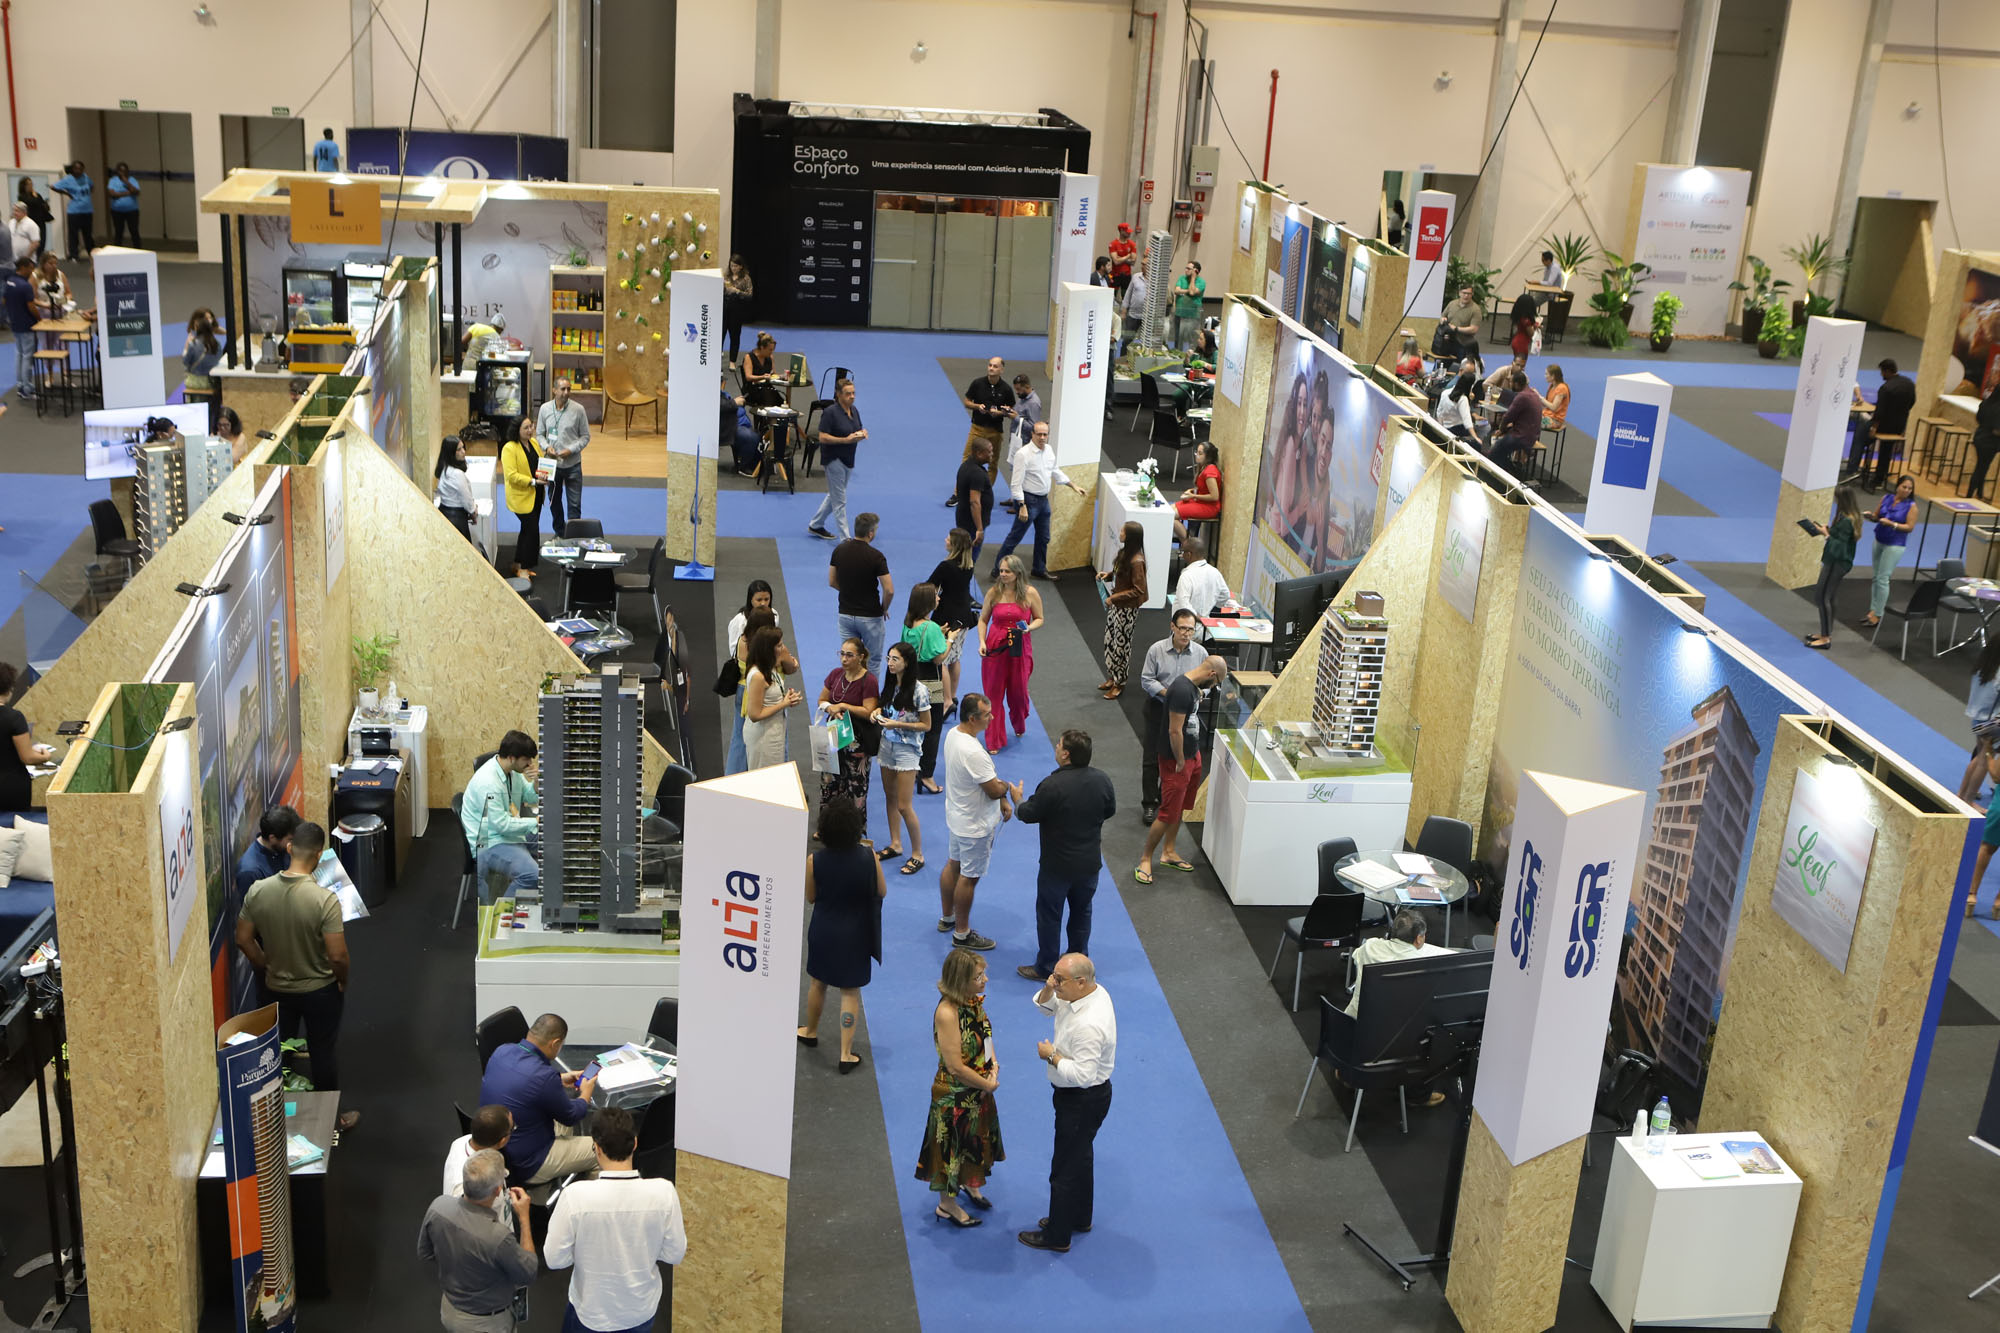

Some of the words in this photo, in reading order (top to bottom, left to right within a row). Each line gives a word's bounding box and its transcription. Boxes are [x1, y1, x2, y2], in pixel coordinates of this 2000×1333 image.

[794, 160, 859, 179] Conforto
[795, 145, 848, 161] Espaço
[871, 160, 890, 168] Uma
[891, 161, 932, 170] experiência
[934, 163, 966, 171] sensorial
[985, 165, 1017, 173] Acústica
[1024, 166, 1063, 175] Iluminação
[1078, 197, 1089, 227] PRIMA
[701, 304, 709, 336] HELENA
[1086, 310, 1095, 360] CONCRETA
[700, 337, 708, 366] SANTA
[1445, 529, 1470, 577] Leaf
[1528, 566, 1547, 592] SEU
[1546, 581, 1560, 604] 2/4
[1560, 591, 1584, 624] COM
[1585, 611, 1615, 649] SUÍTE
[1616, 635, 1624, 657] E
[1526, 589, 1567, 641] VARANDA
[1570, 629, 1622, 689] GOURMET.
[1521, 616, 1535, 639] NO
[1536, 628, 1570, 671] MORRO
[1572, 660, 1622, 719] IPIRANGA.
[1556, 687, 1564, 702] DA
[1307, 783, 1339, 803] Leaf
[1785, 825, 1838, 896] Leaf
[761, 877, 774, 978] EMPREENDIMENTOS
[1594, 859, 1616, 972] EMPREENDIMENTOS
